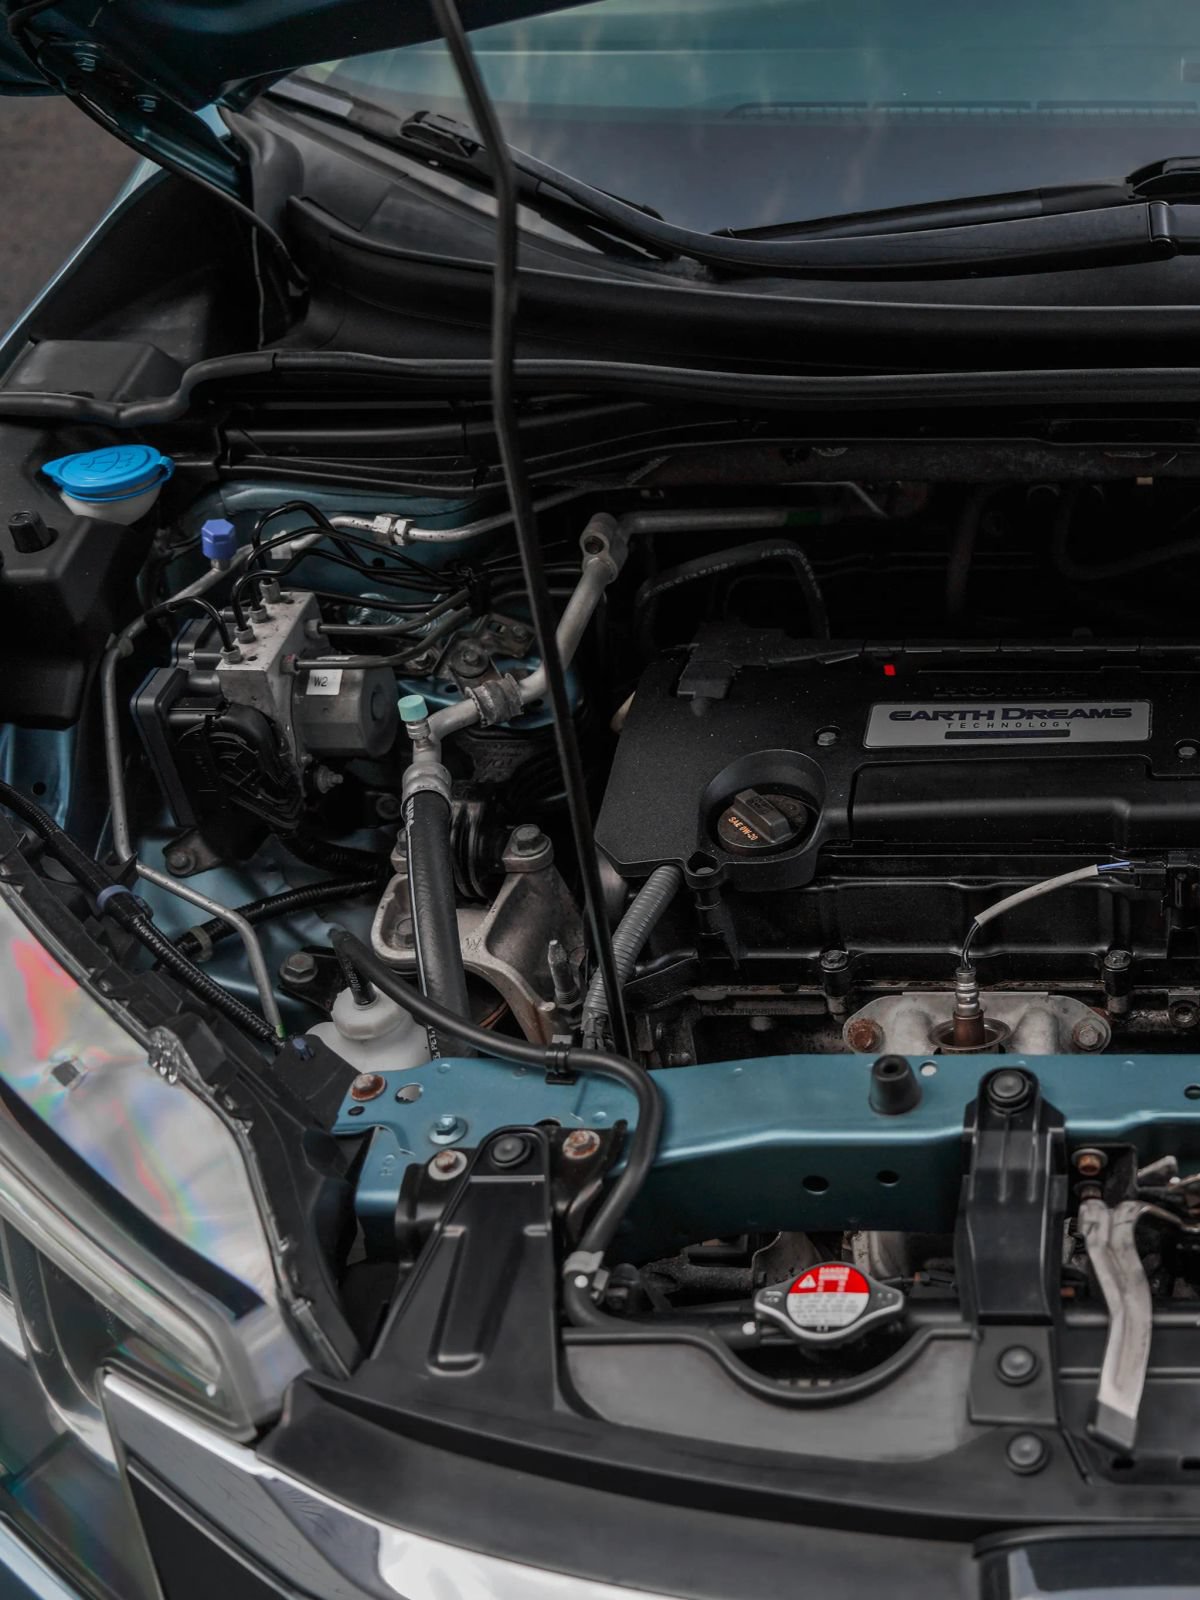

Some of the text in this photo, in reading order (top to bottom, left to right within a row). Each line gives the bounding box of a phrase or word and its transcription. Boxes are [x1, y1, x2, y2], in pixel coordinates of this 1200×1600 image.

[314, 676, 328, 687] W2
[888, 707, 1133, 721] EARTH DREAMS
[945, 721, 1073, 729] TECHNOLOGY
[728, 816, 744, 828] SAE
